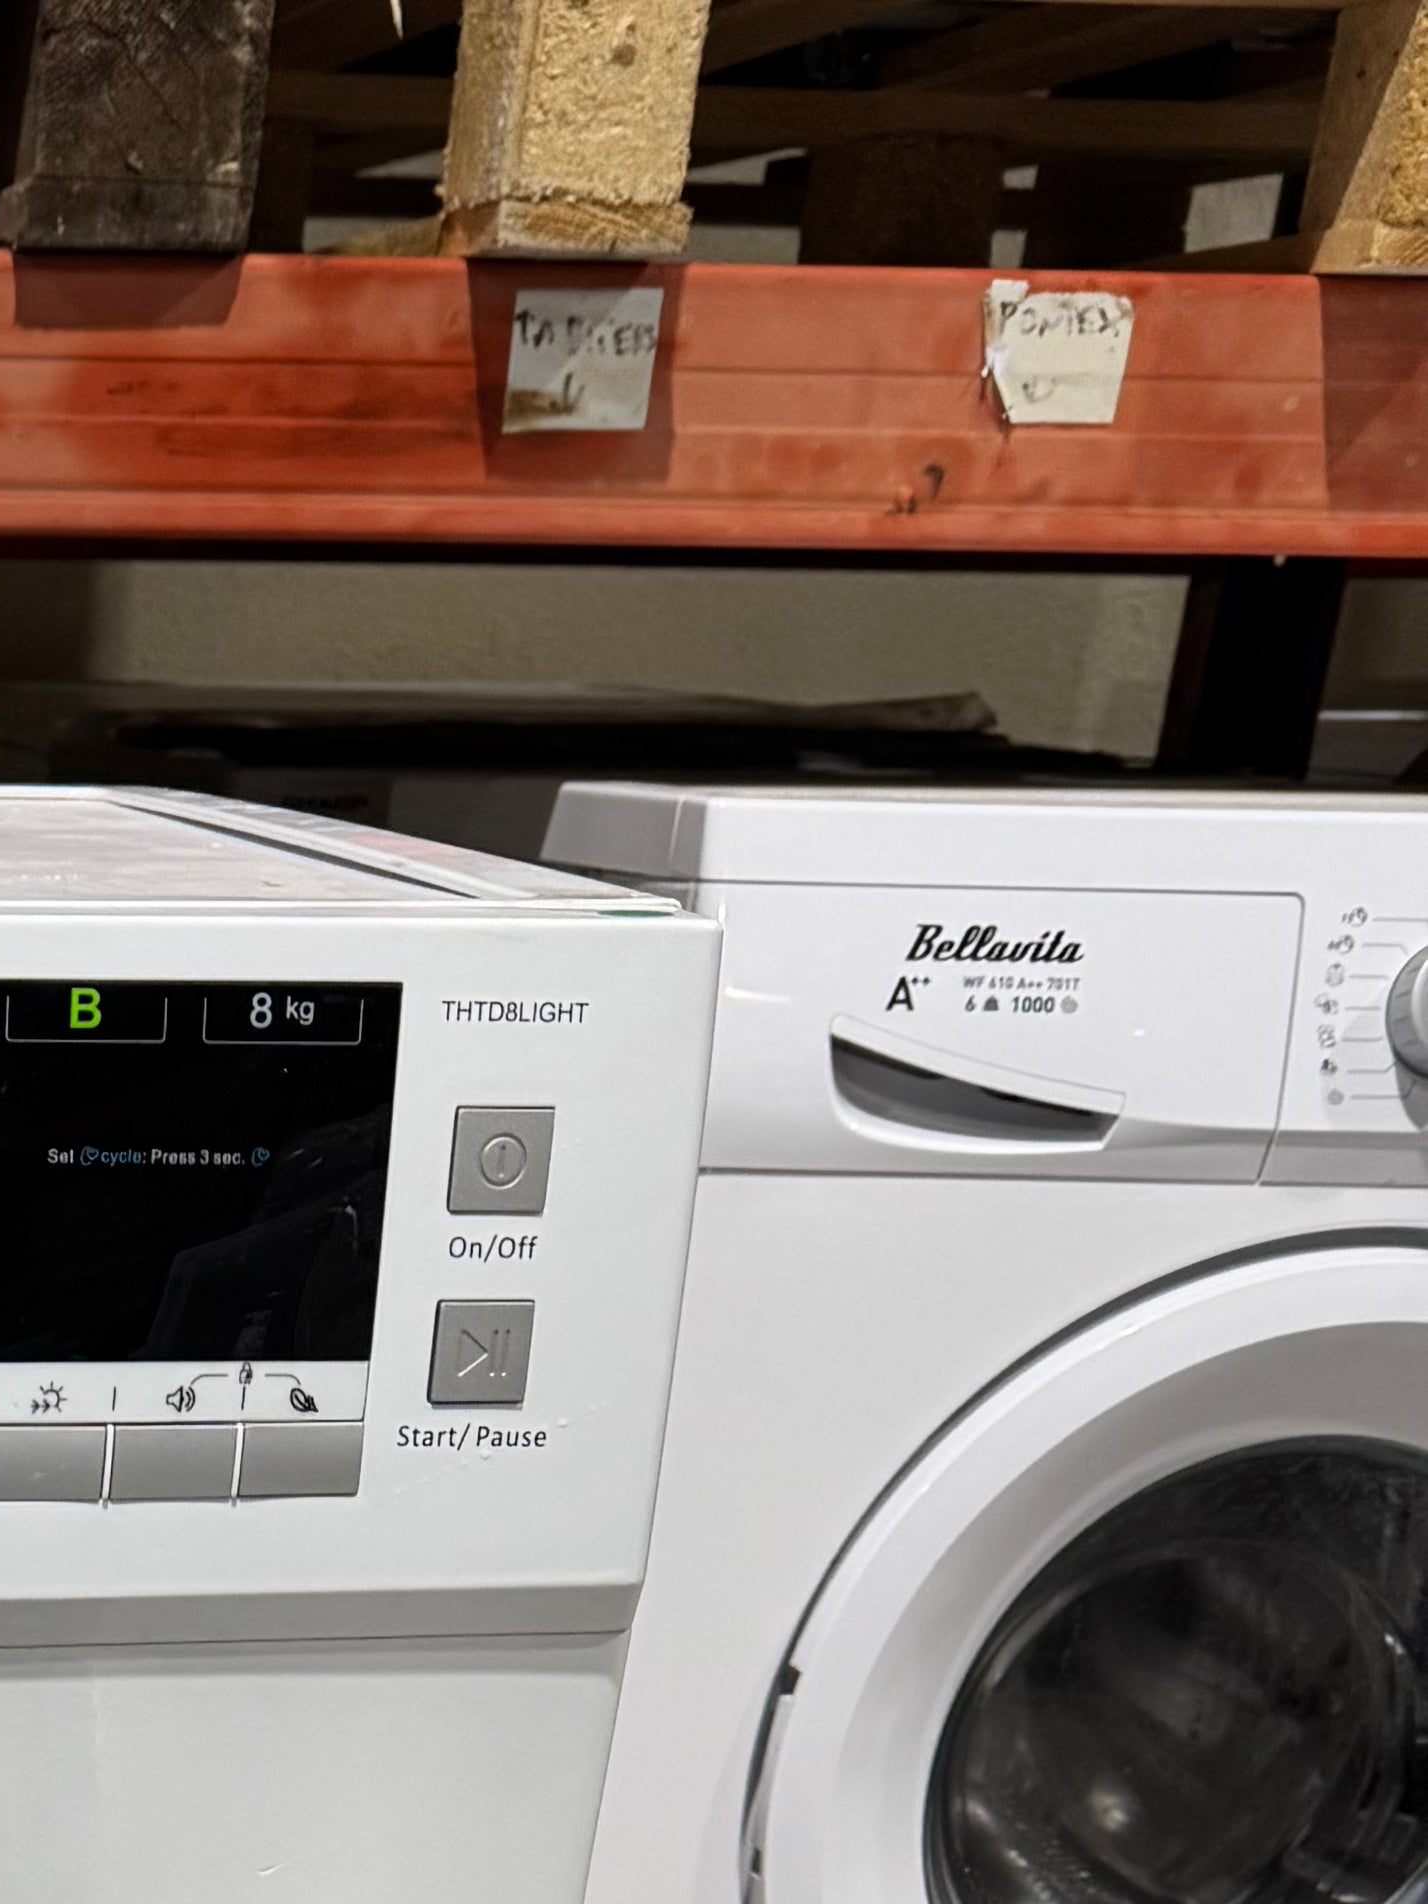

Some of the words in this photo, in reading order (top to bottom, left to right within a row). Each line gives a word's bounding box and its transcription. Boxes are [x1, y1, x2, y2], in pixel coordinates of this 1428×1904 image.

[904, 923, 1085, 963] Bellavita
[69, 987, 102, 1029] B
[250, 992, 273, 1029] 8
[286, 995, 315, 1025] kg
[442, 1000, 589, 1024] THTD8LIGHT
[964, 994, 977, 1012] 6
[1012, 996, 1057, 1013] 1000
[448, 1235, 538, 1262] On/Off
[476, 1426, 548, 1448] Pause
